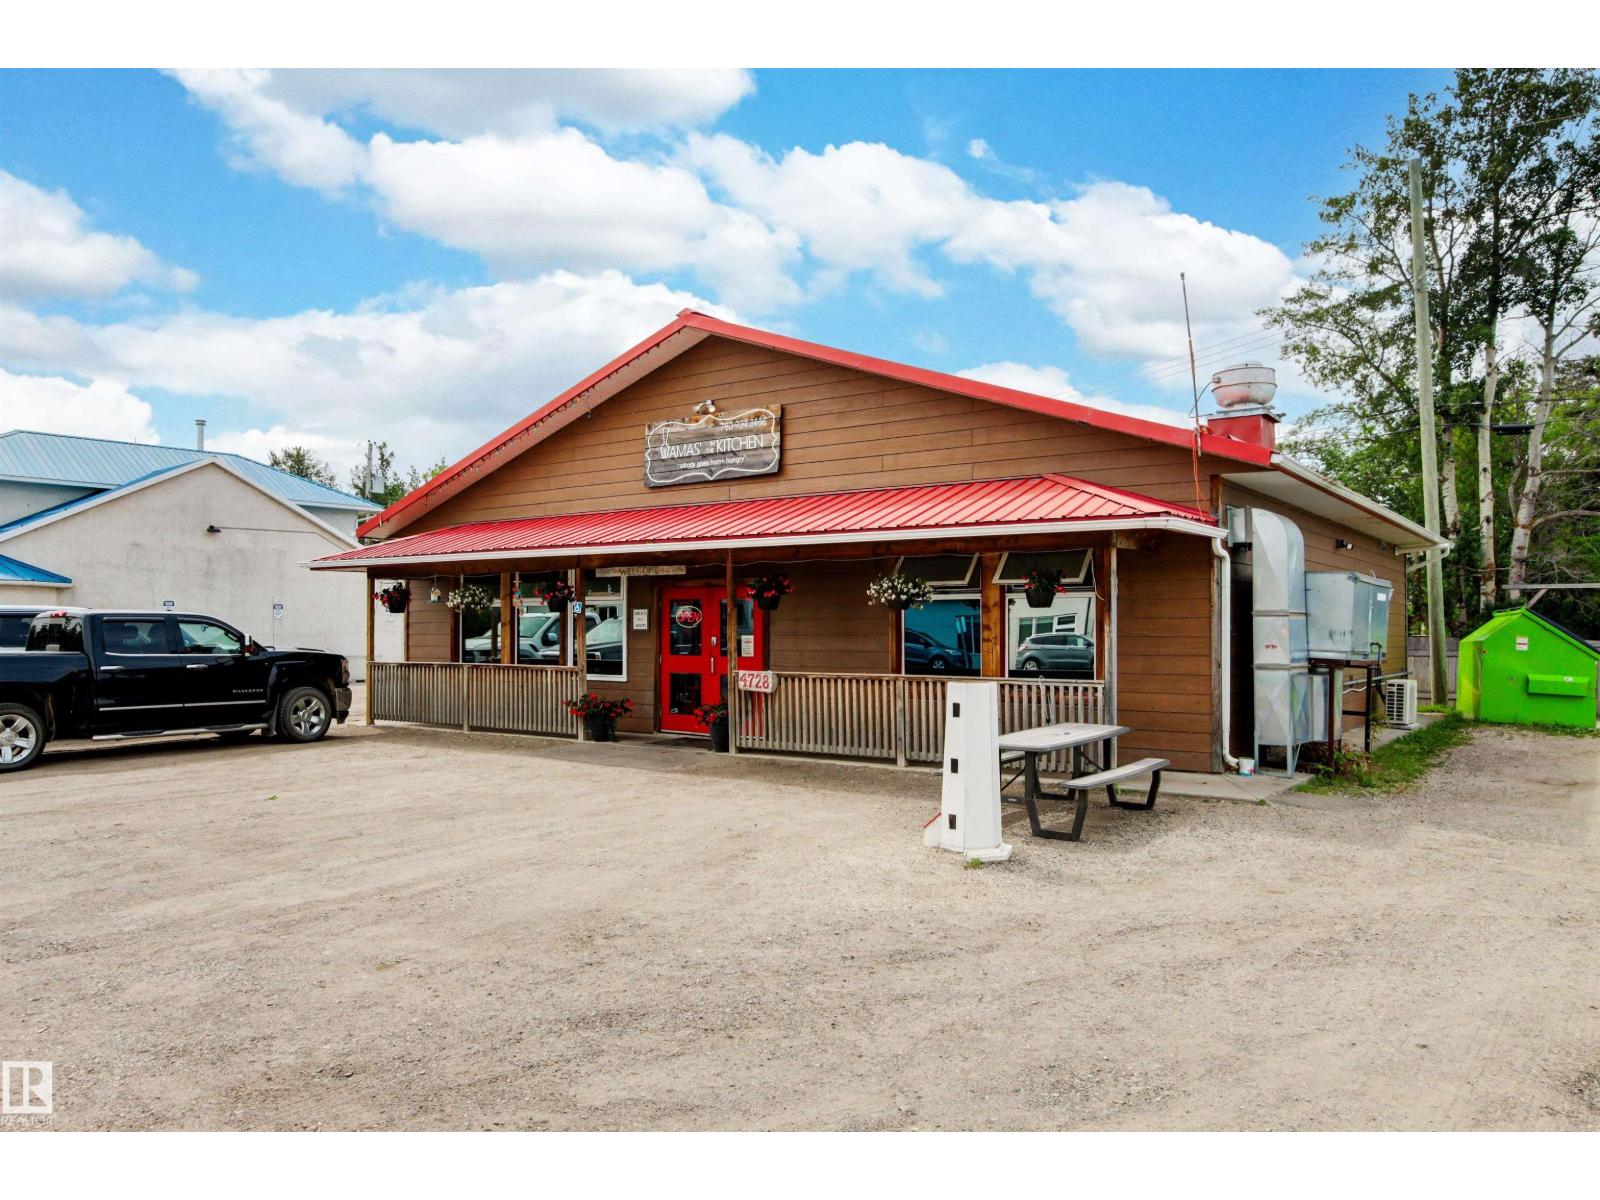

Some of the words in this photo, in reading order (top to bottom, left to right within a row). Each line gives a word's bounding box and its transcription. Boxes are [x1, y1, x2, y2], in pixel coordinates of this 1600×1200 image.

[716, 435, 764, 453] KITCHEN
[696, 460, 709, 468] goes
[725, 455, 746, 464] hungry
[677, 611, 700, 623] OPEN
[739, 673, 770, 690] 4728
